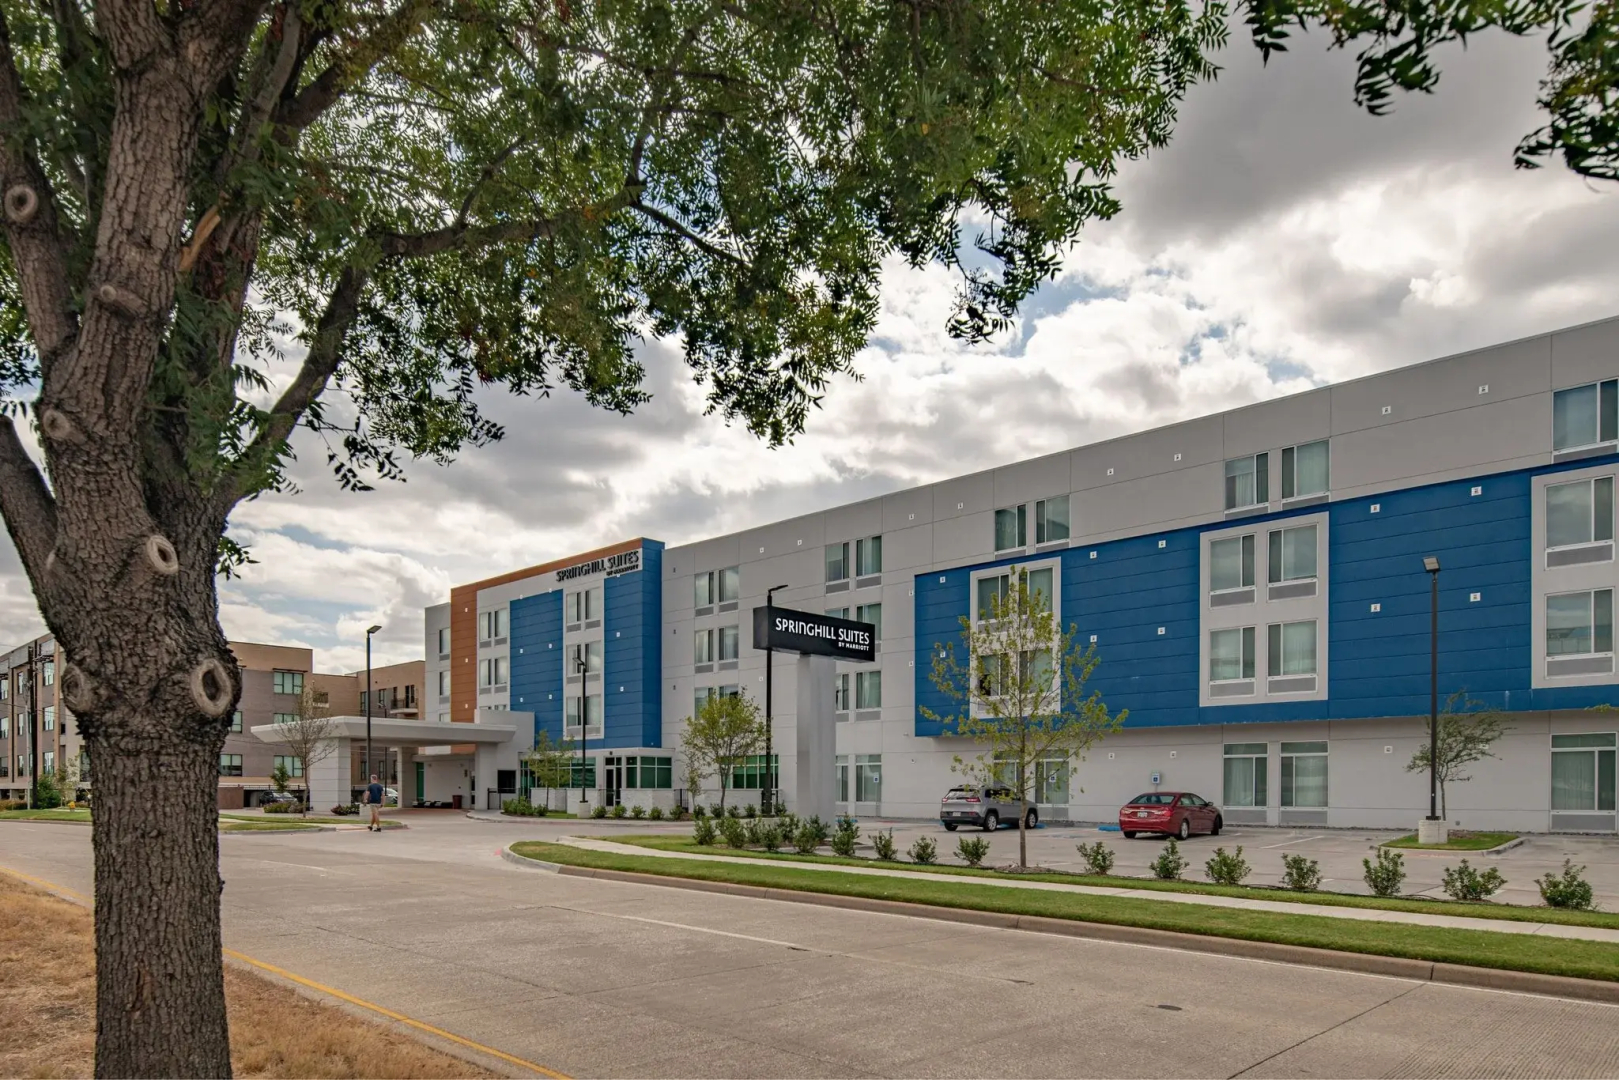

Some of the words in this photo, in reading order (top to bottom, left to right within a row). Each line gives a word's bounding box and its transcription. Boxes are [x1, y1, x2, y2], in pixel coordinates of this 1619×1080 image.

[556, 559, 606, 582] SPRINGHILL
[607, 550, 639, 569] SUITES
[776, 618, 836, 639] SPRINGHILL
[838, 628, 870, 644] SUITES
[845, 643, 869, 651] MARRIOTT
